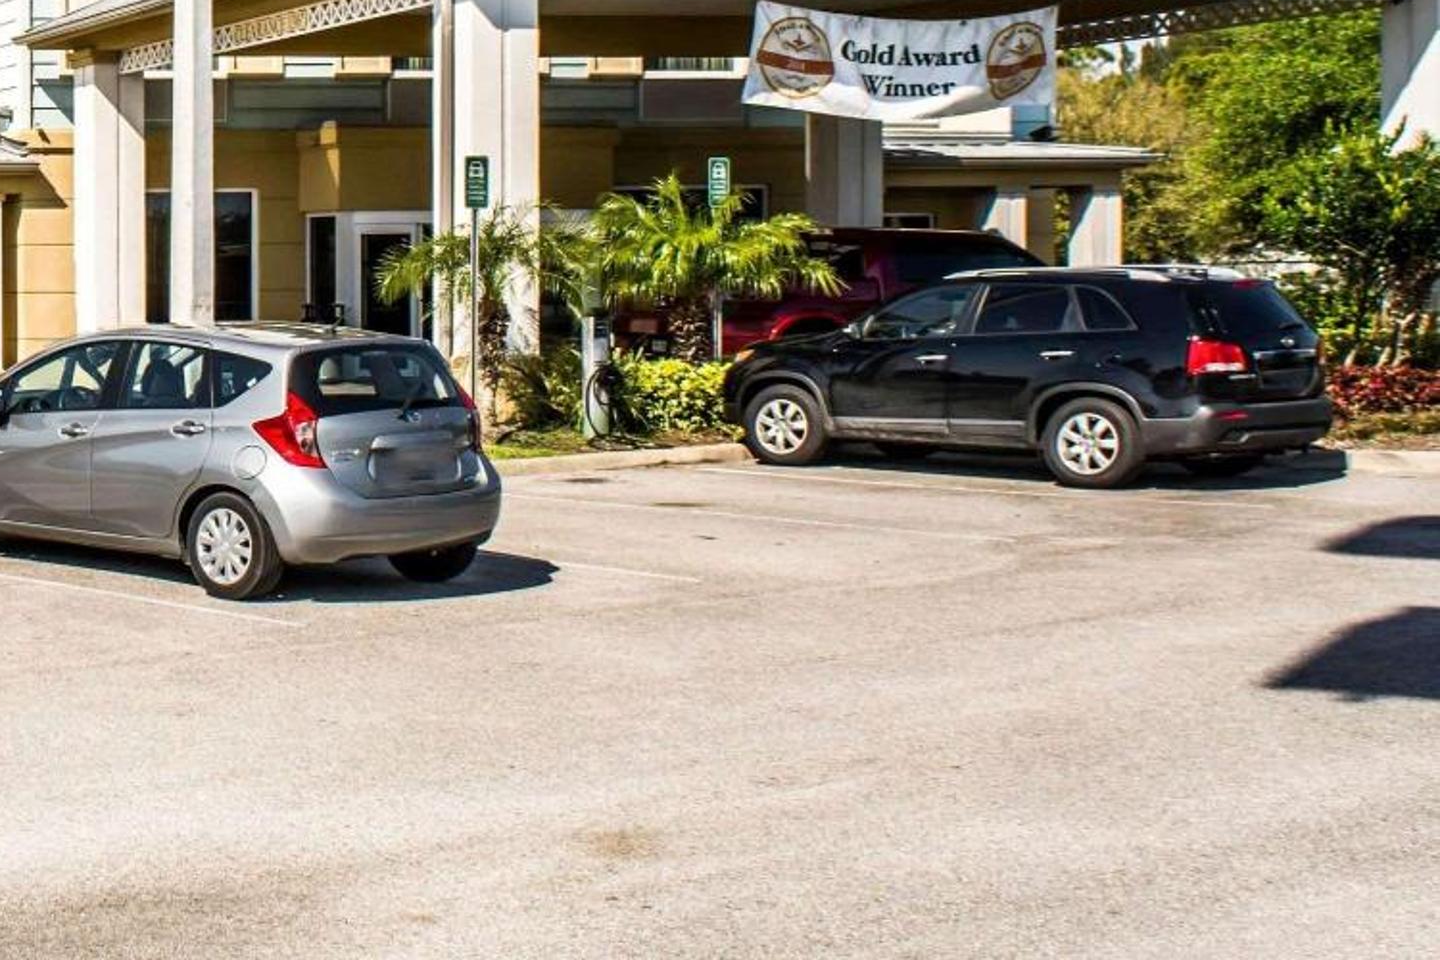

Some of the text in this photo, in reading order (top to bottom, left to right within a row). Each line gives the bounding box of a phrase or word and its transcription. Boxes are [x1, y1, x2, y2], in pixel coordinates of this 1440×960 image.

[841, 39, 982, 67] Gold Award
[862, 74, 956, 97] Winner
